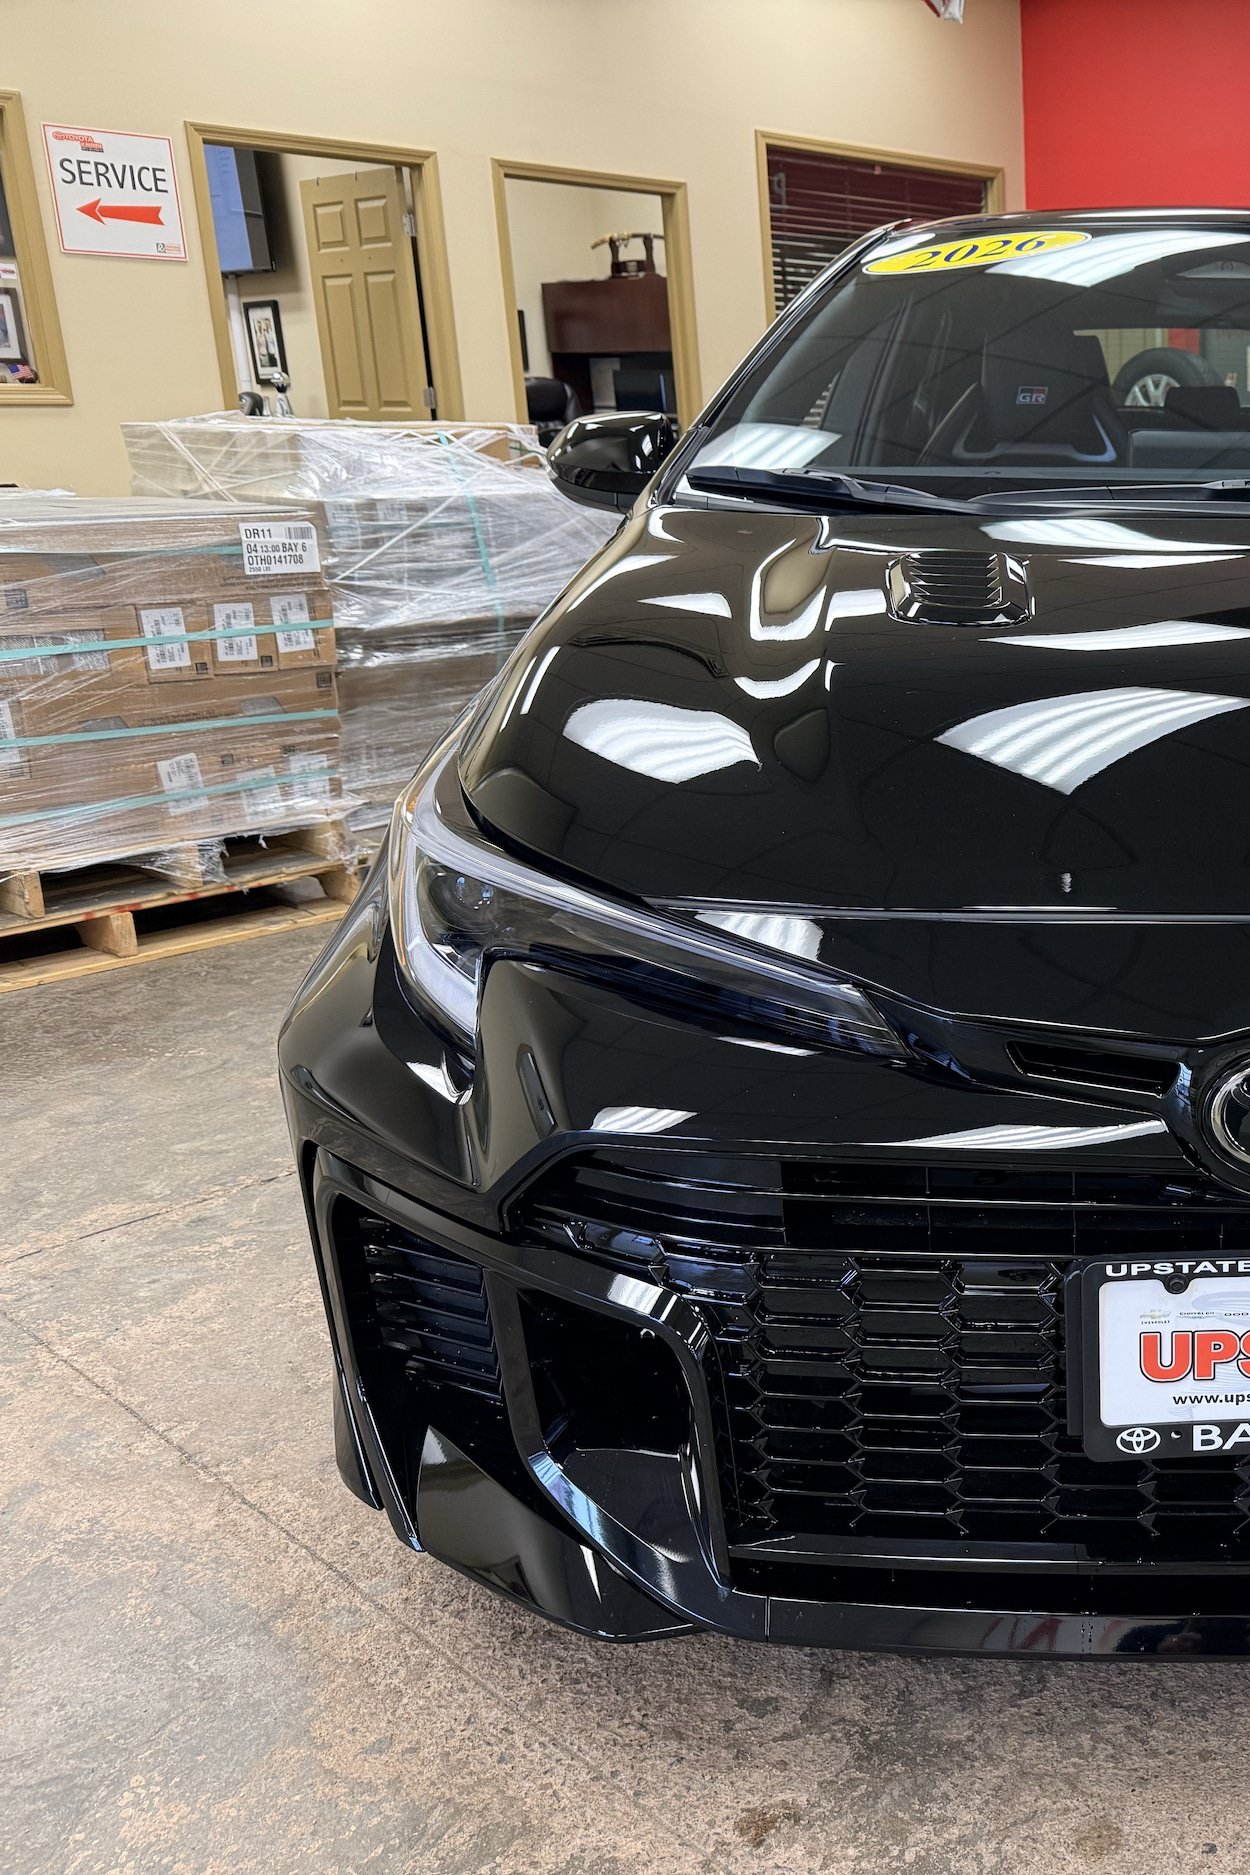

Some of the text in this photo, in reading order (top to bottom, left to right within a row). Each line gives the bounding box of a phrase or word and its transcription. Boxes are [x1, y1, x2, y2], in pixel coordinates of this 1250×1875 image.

[59, 157, 169, 194] SERVICE
[904, 234, 1046, 270] 2026
[1019, 393, 1046, 402] GR
[244, 528, 272, 539] DR11
[246, 542, 307, 554] 04 13:00 BAY 6
